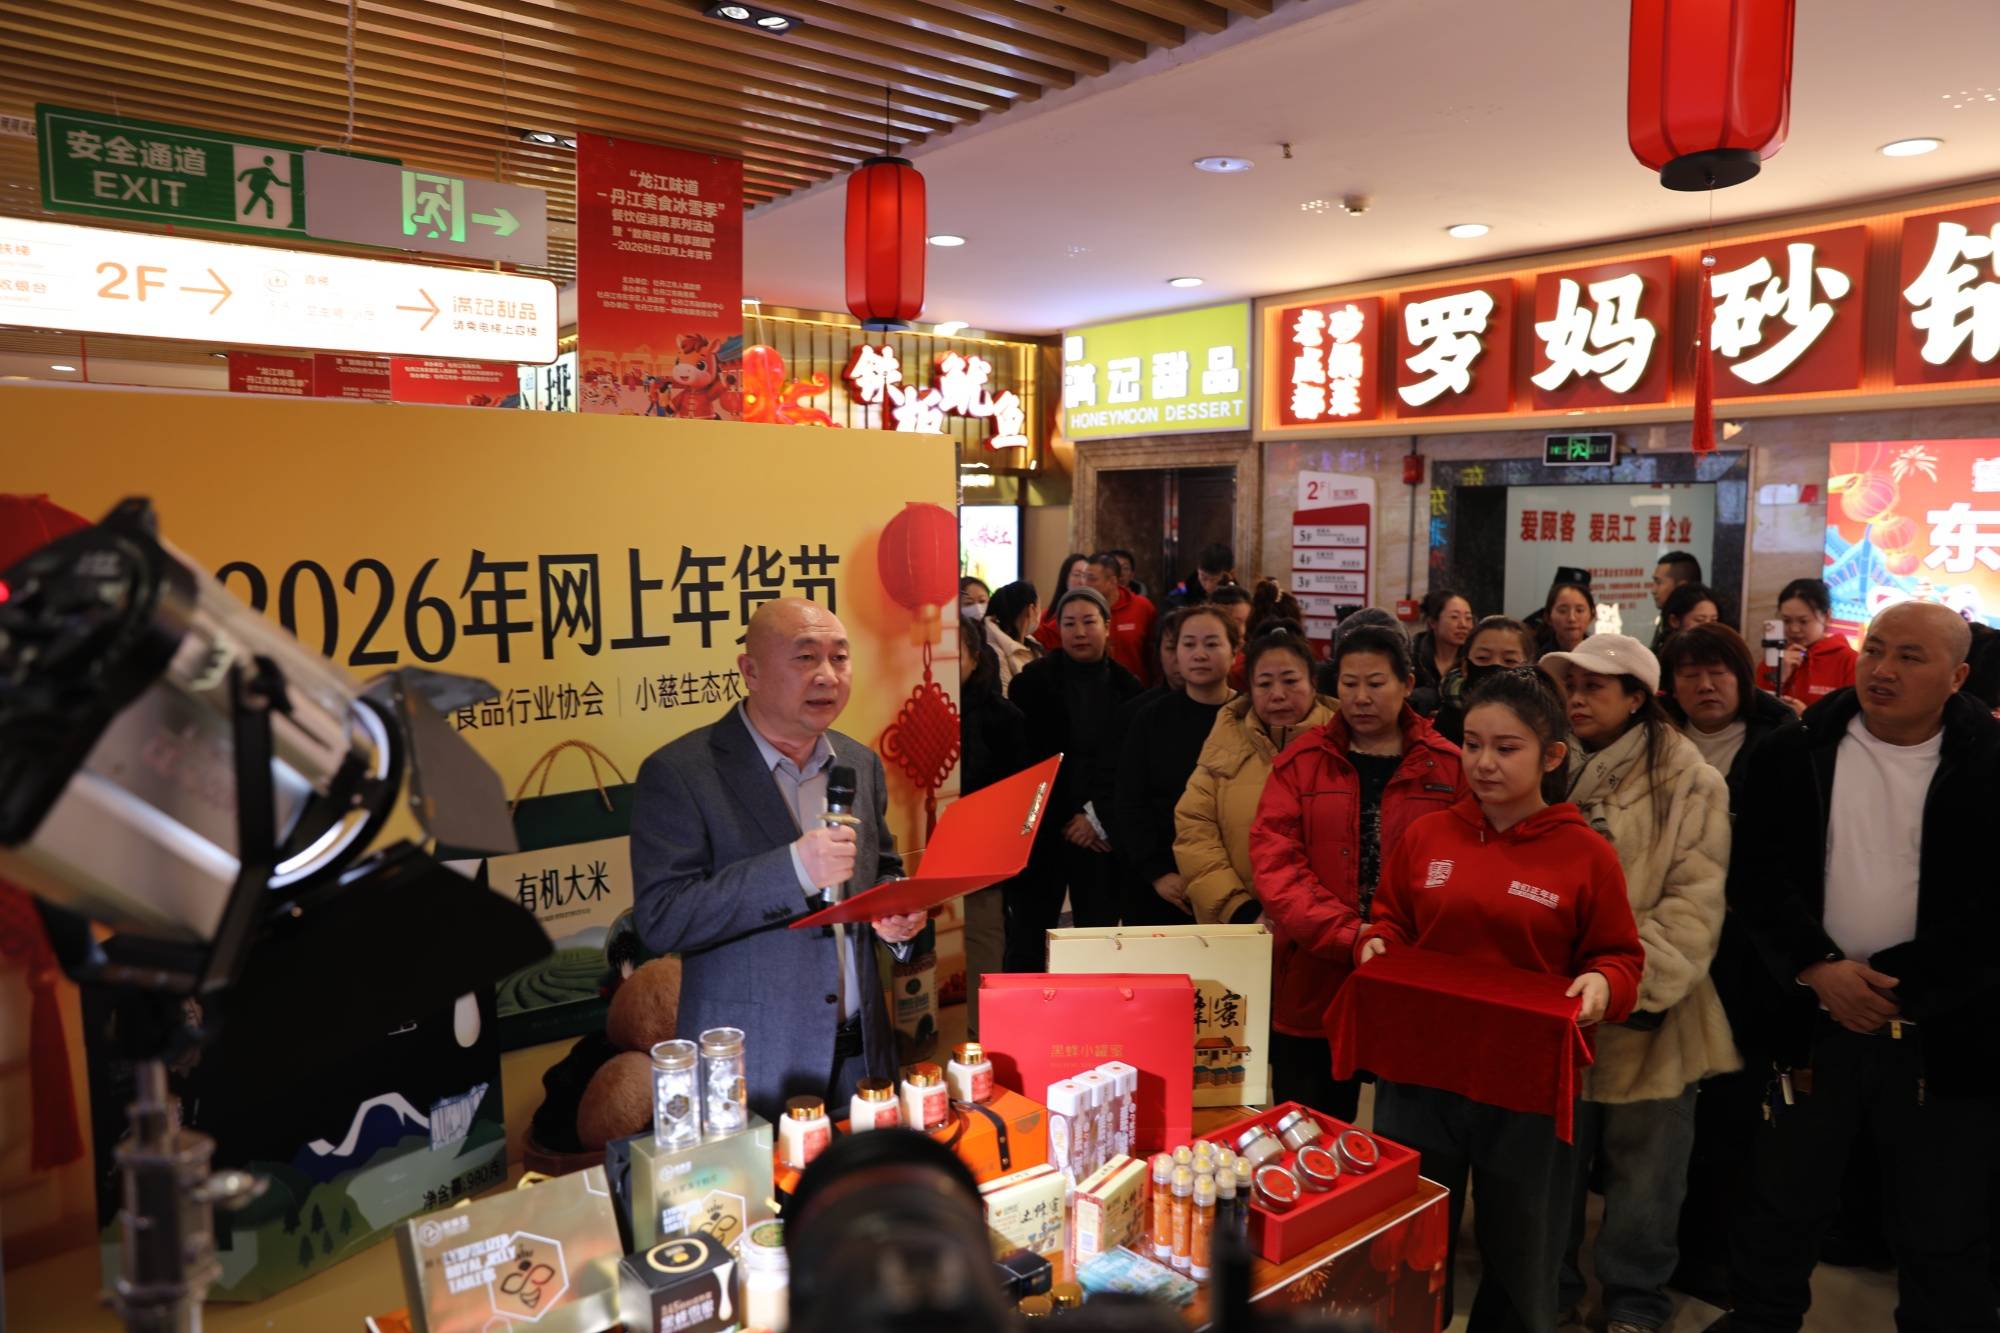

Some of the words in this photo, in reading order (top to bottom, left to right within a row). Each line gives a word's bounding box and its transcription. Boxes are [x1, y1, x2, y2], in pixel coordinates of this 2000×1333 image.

[66, 130, 207, 177] 安全通道
[93, 169, 187, 207] EXIT
[96, 261, 168, 302] 2F
[1070, 406, 1159, 429] HONEYMOON
[1164, 399, 1244, 422] DESSERT
[1520, 510, 1577, 543] 爱顾客
[1588, 512, 1637, 543] 爱员工
[1647, 514, 1693, 544] 爱企业
[635, 669, 742, 712] 小慈生态农
[515, 860, 611, 913] 有机大米
